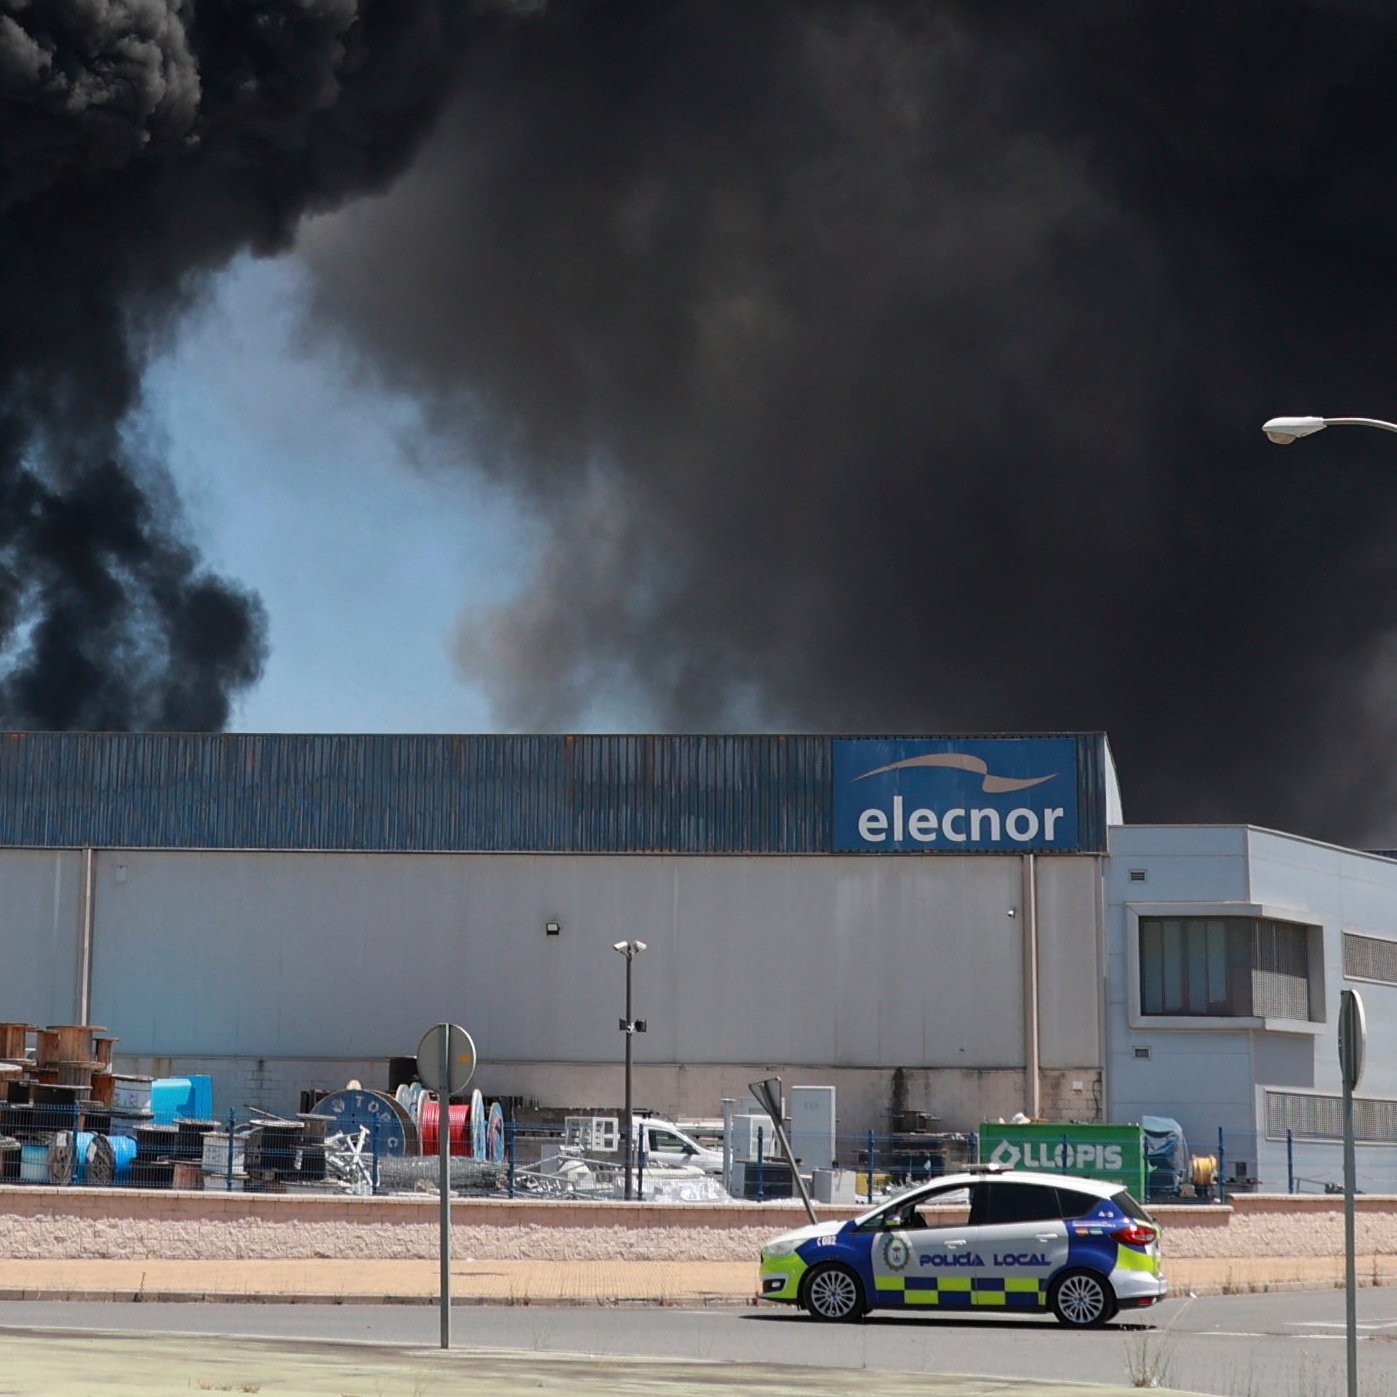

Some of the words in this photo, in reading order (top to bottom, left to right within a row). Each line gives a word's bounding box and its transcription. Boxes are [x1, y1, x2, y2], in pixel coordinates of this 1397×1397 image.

[858, 795, 1064, 842] elecnor
[1024, 1142, 1123, 1170] LLOPIS
[993, 1253, 1052, 1267] LOCAL
